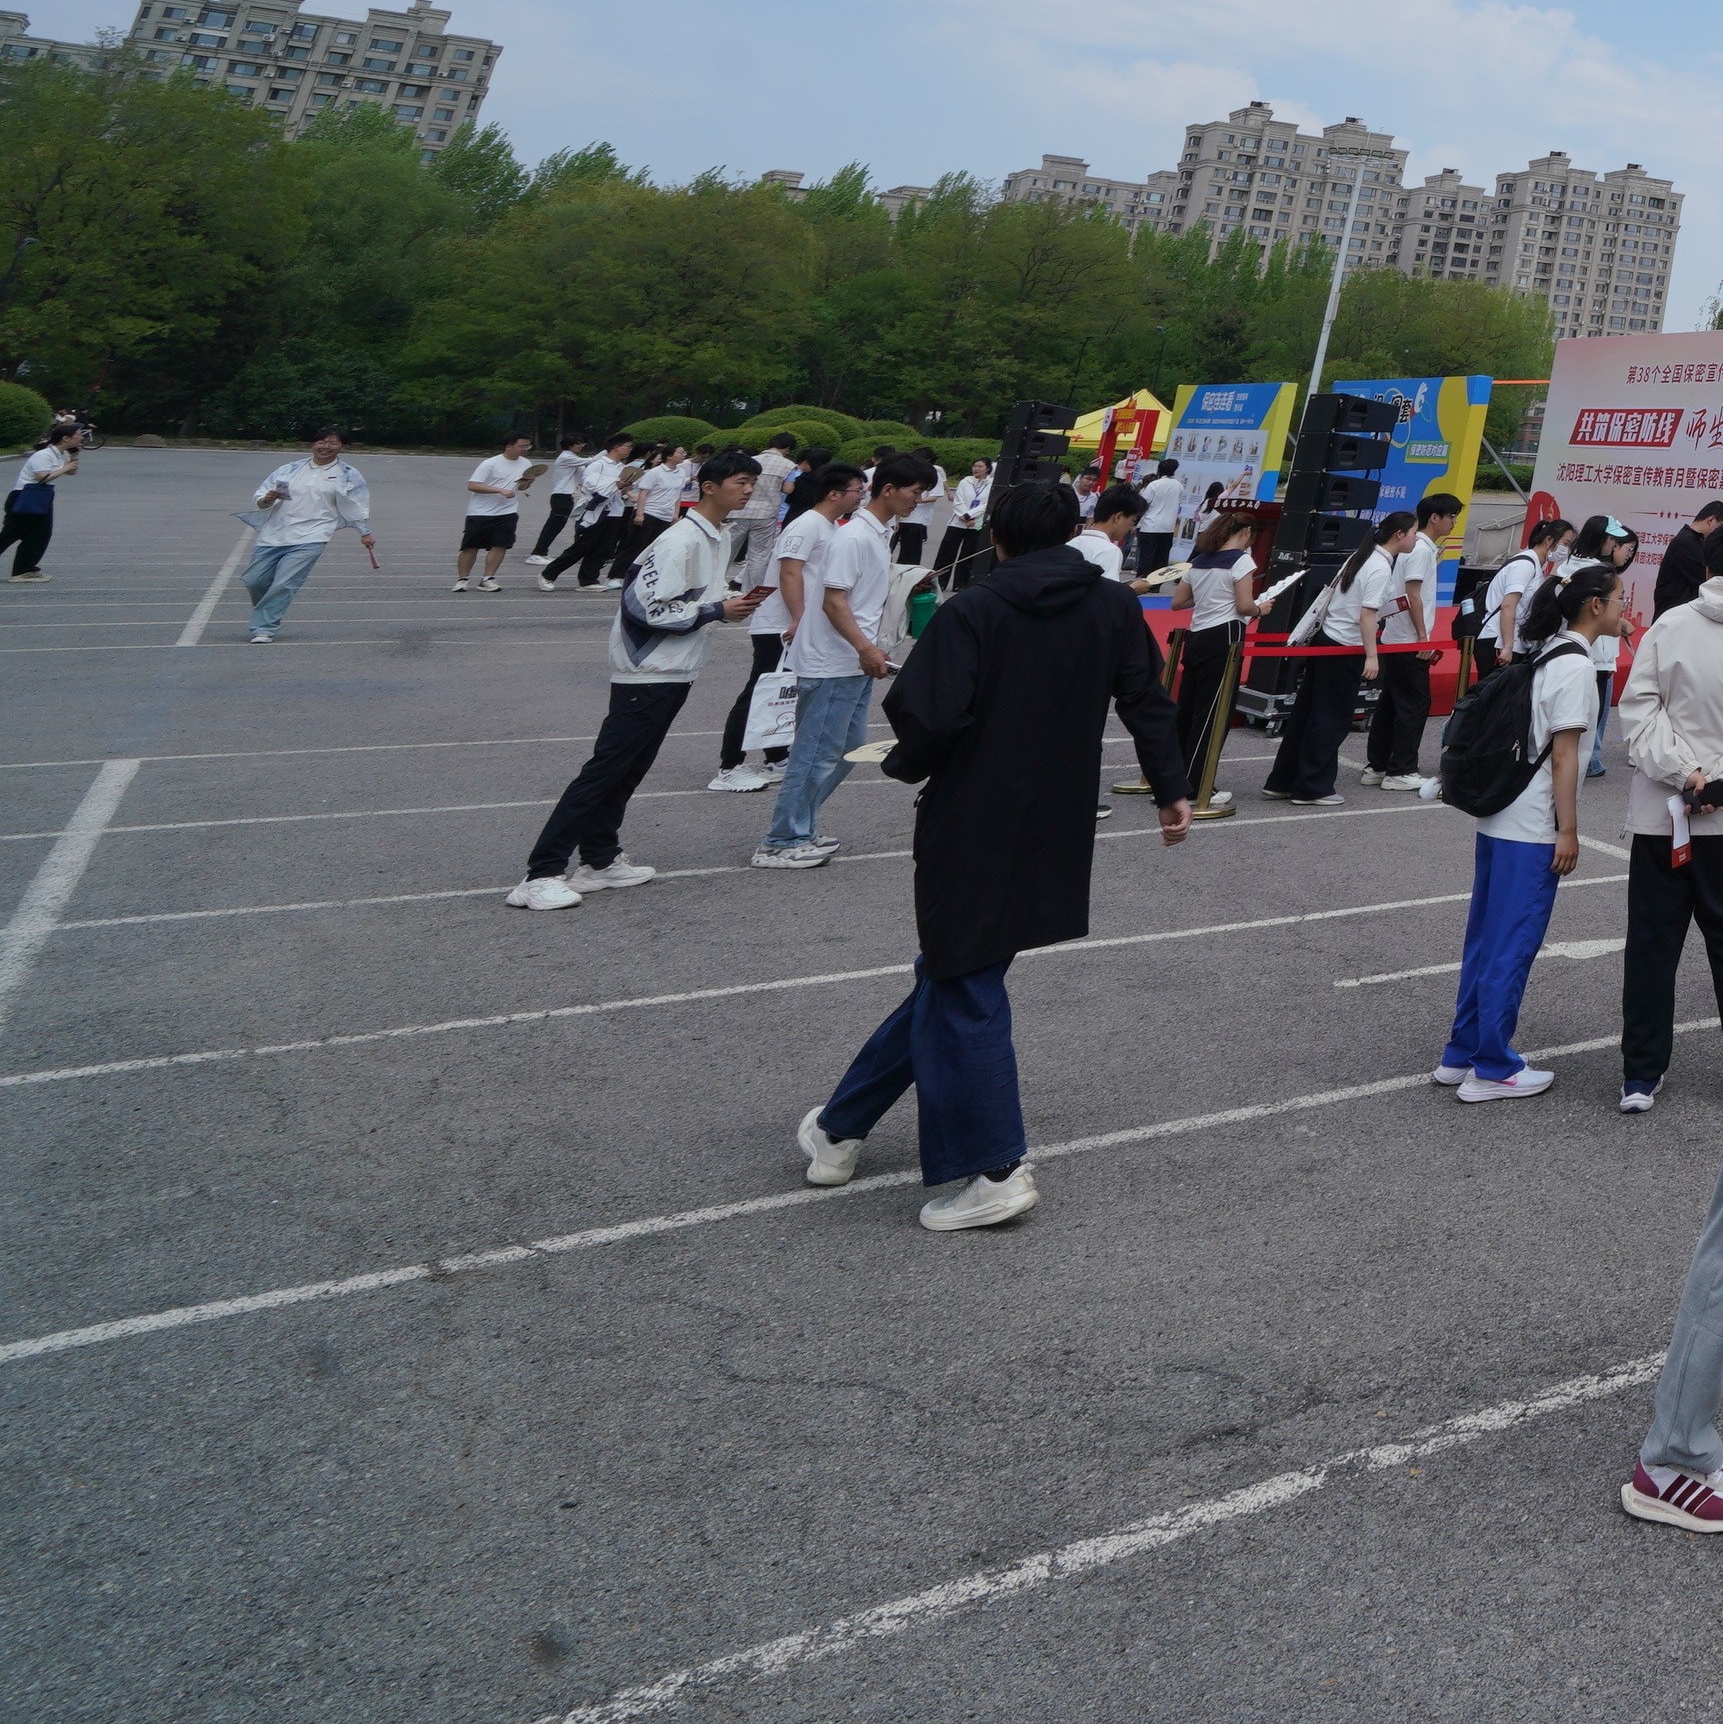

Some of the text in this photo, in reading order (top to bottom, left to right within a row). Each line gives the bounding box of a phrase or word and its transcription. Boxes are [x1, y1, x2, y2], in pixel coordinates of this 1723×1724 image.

[1575, 412, 1676, 444] 共筑保密防线
